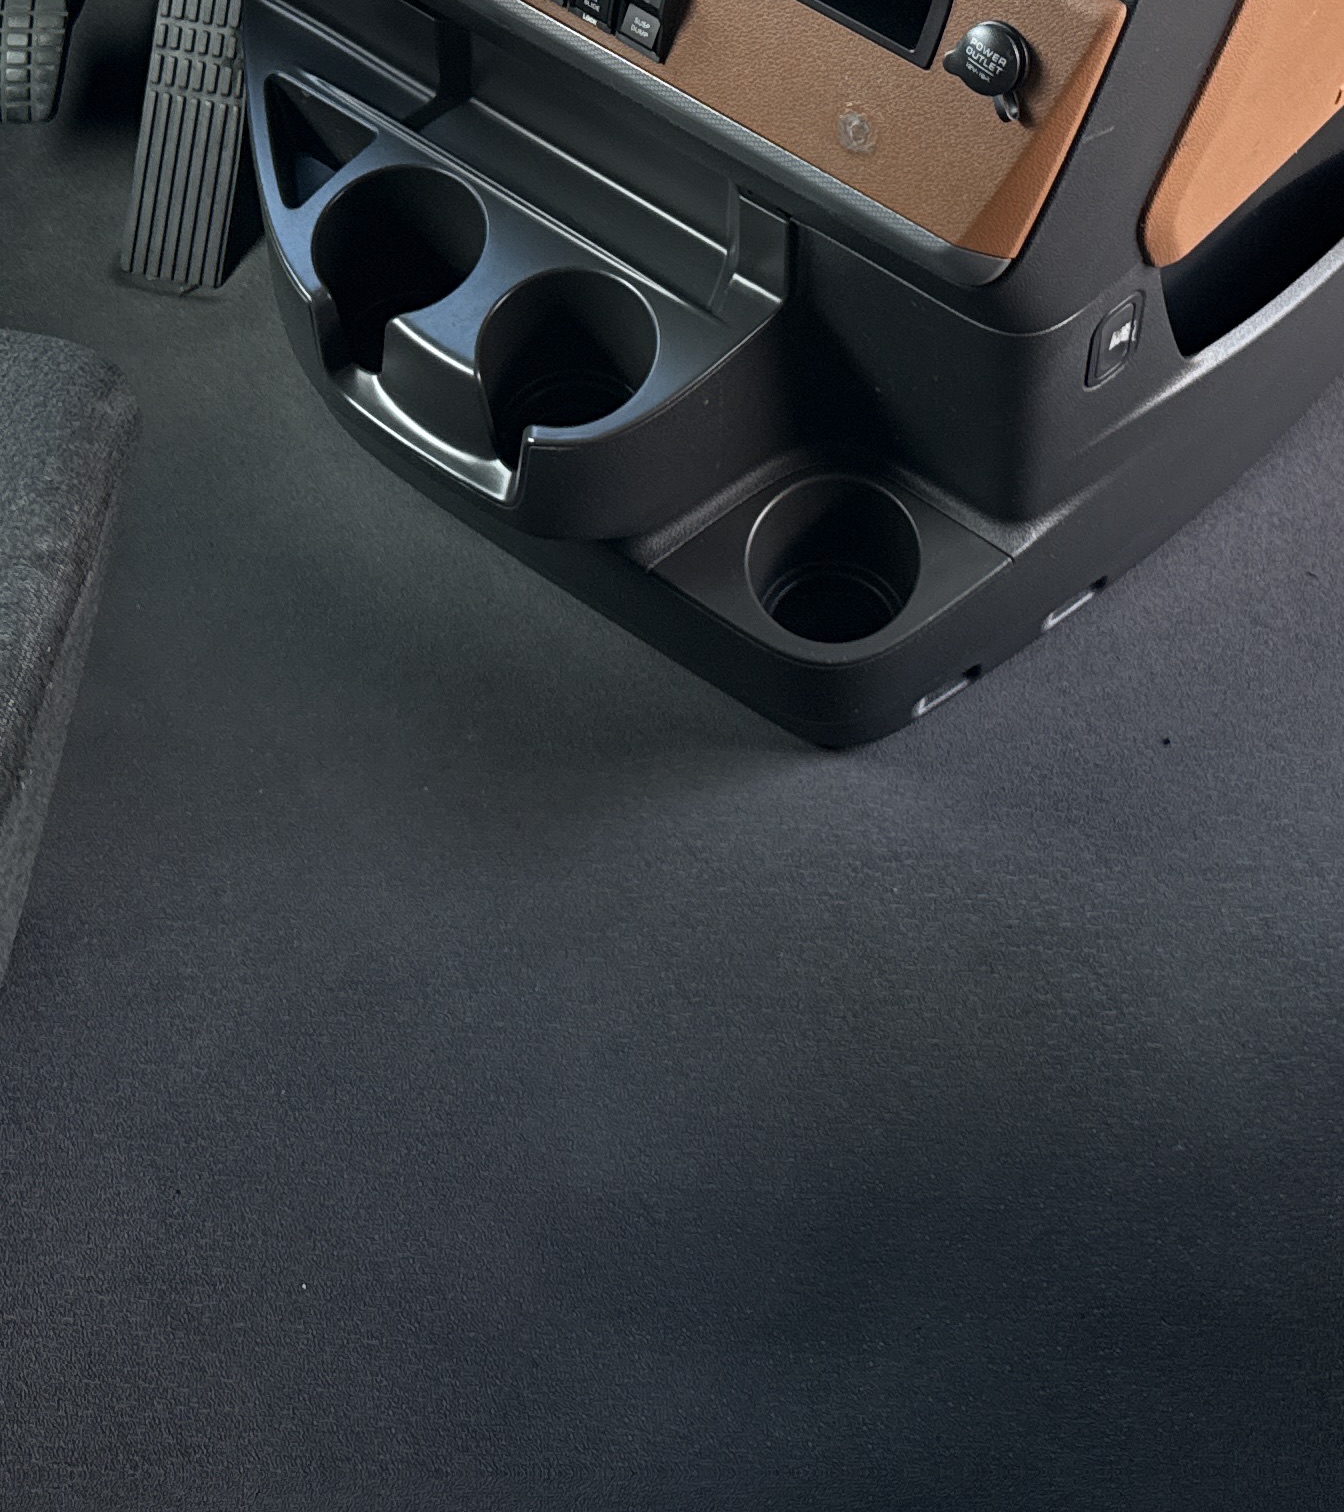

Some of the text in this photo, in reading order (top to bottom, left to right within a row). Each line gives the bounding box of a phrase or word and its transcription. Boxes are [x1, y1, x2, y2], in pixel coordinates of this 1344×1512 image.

[582, 13, 598, 26] LOCK
[966, 46, 1003, 75] OUTLET
[970, 37, 1007, 67] POWER
